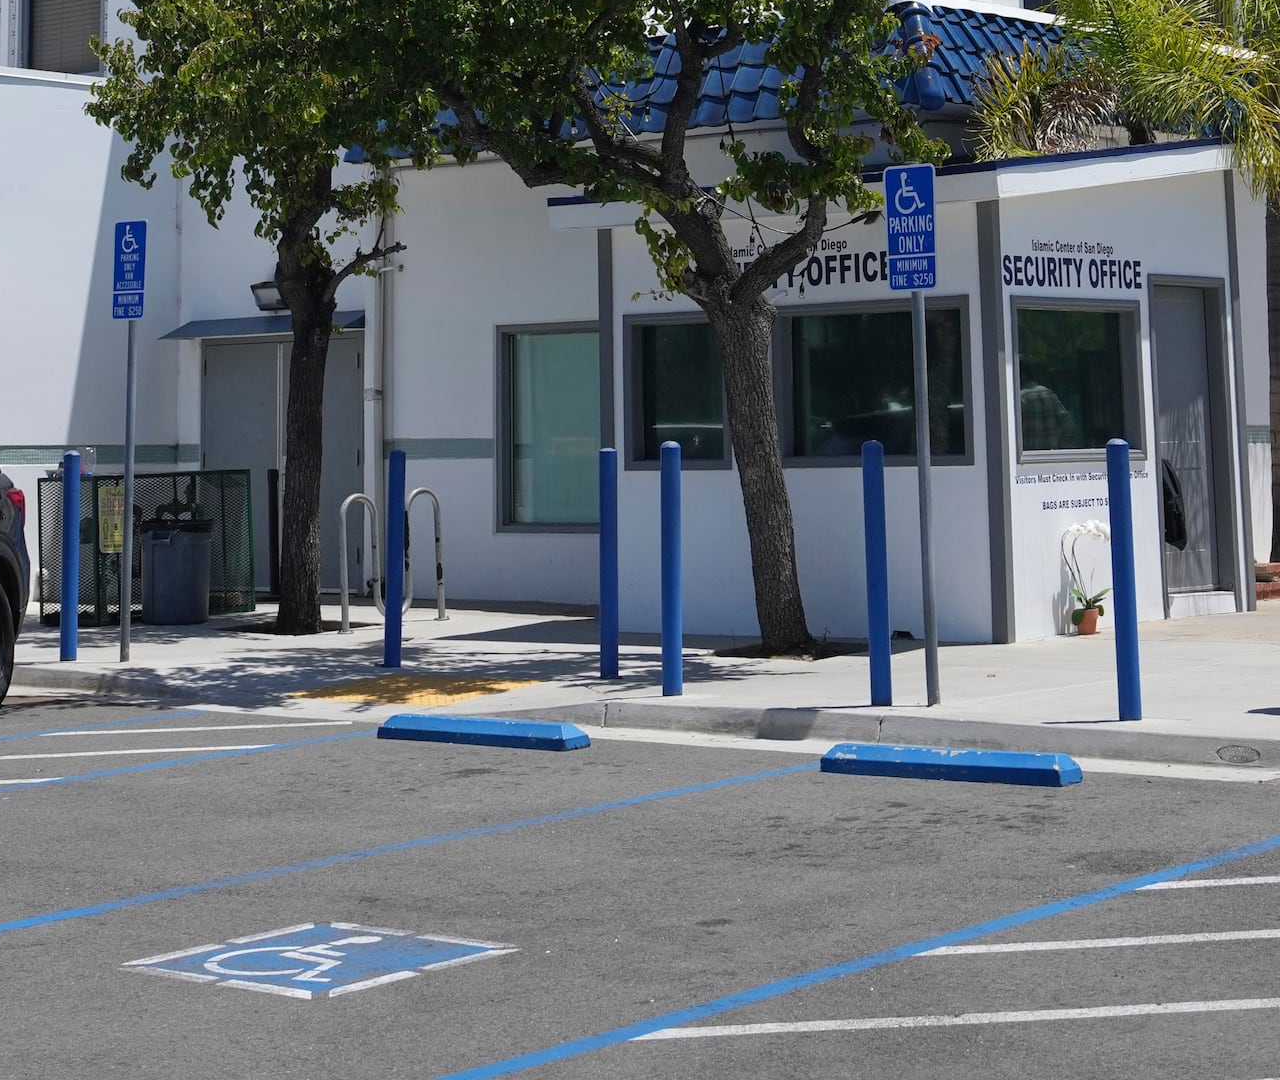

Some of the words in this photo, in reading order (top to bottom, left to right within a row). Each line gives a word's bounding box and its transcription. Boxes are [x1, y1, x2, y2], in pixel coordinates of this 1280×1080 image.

[889, 214, 933, 234] PARKING
[821, 238, 847, 253] Diego
[899, 235, 925, 253] ONLY
[1032, 239, 1054, 252] Islamic
[1056, 240, 1076, 253] Center
[1077, 241, 1083, 254] of
[1084, 242, 1096, 254] San
[1097, 242, 1114, 257] Diego
[120, 253, 139, 262] PARKING
[123, 263, 135, 271] ONLY
[896, 258, 928, 272] MINIMUM
[1003, 254, 1083, 288] SECURITY
[1088, 258, 1142, 289] OFFICE
[892, 274, 908, 287] FINE
[913, 273, 934, 286] $250
[117, 295, 139, 304] MINIMUM
[114, 306, 125, 317] FINE
[127, 306, 142, 317] $250
[1015, 475, 1037, 485] Visitors
[1038, 474, 1051, 483] Must
[1052, 473, 1068, 482] Check
[1076, 472, 1087, 481] with
[1089, 472, 1108, 481] Securit
[1134, 470, 1149, 479] Office
[1042, 501, 1057, 510] BAGS
[1059, 500, 1069, 509] ARE
[1071, 498, 1095, 508] SUBJECT
[1096, 498, 1104, 507] TO
